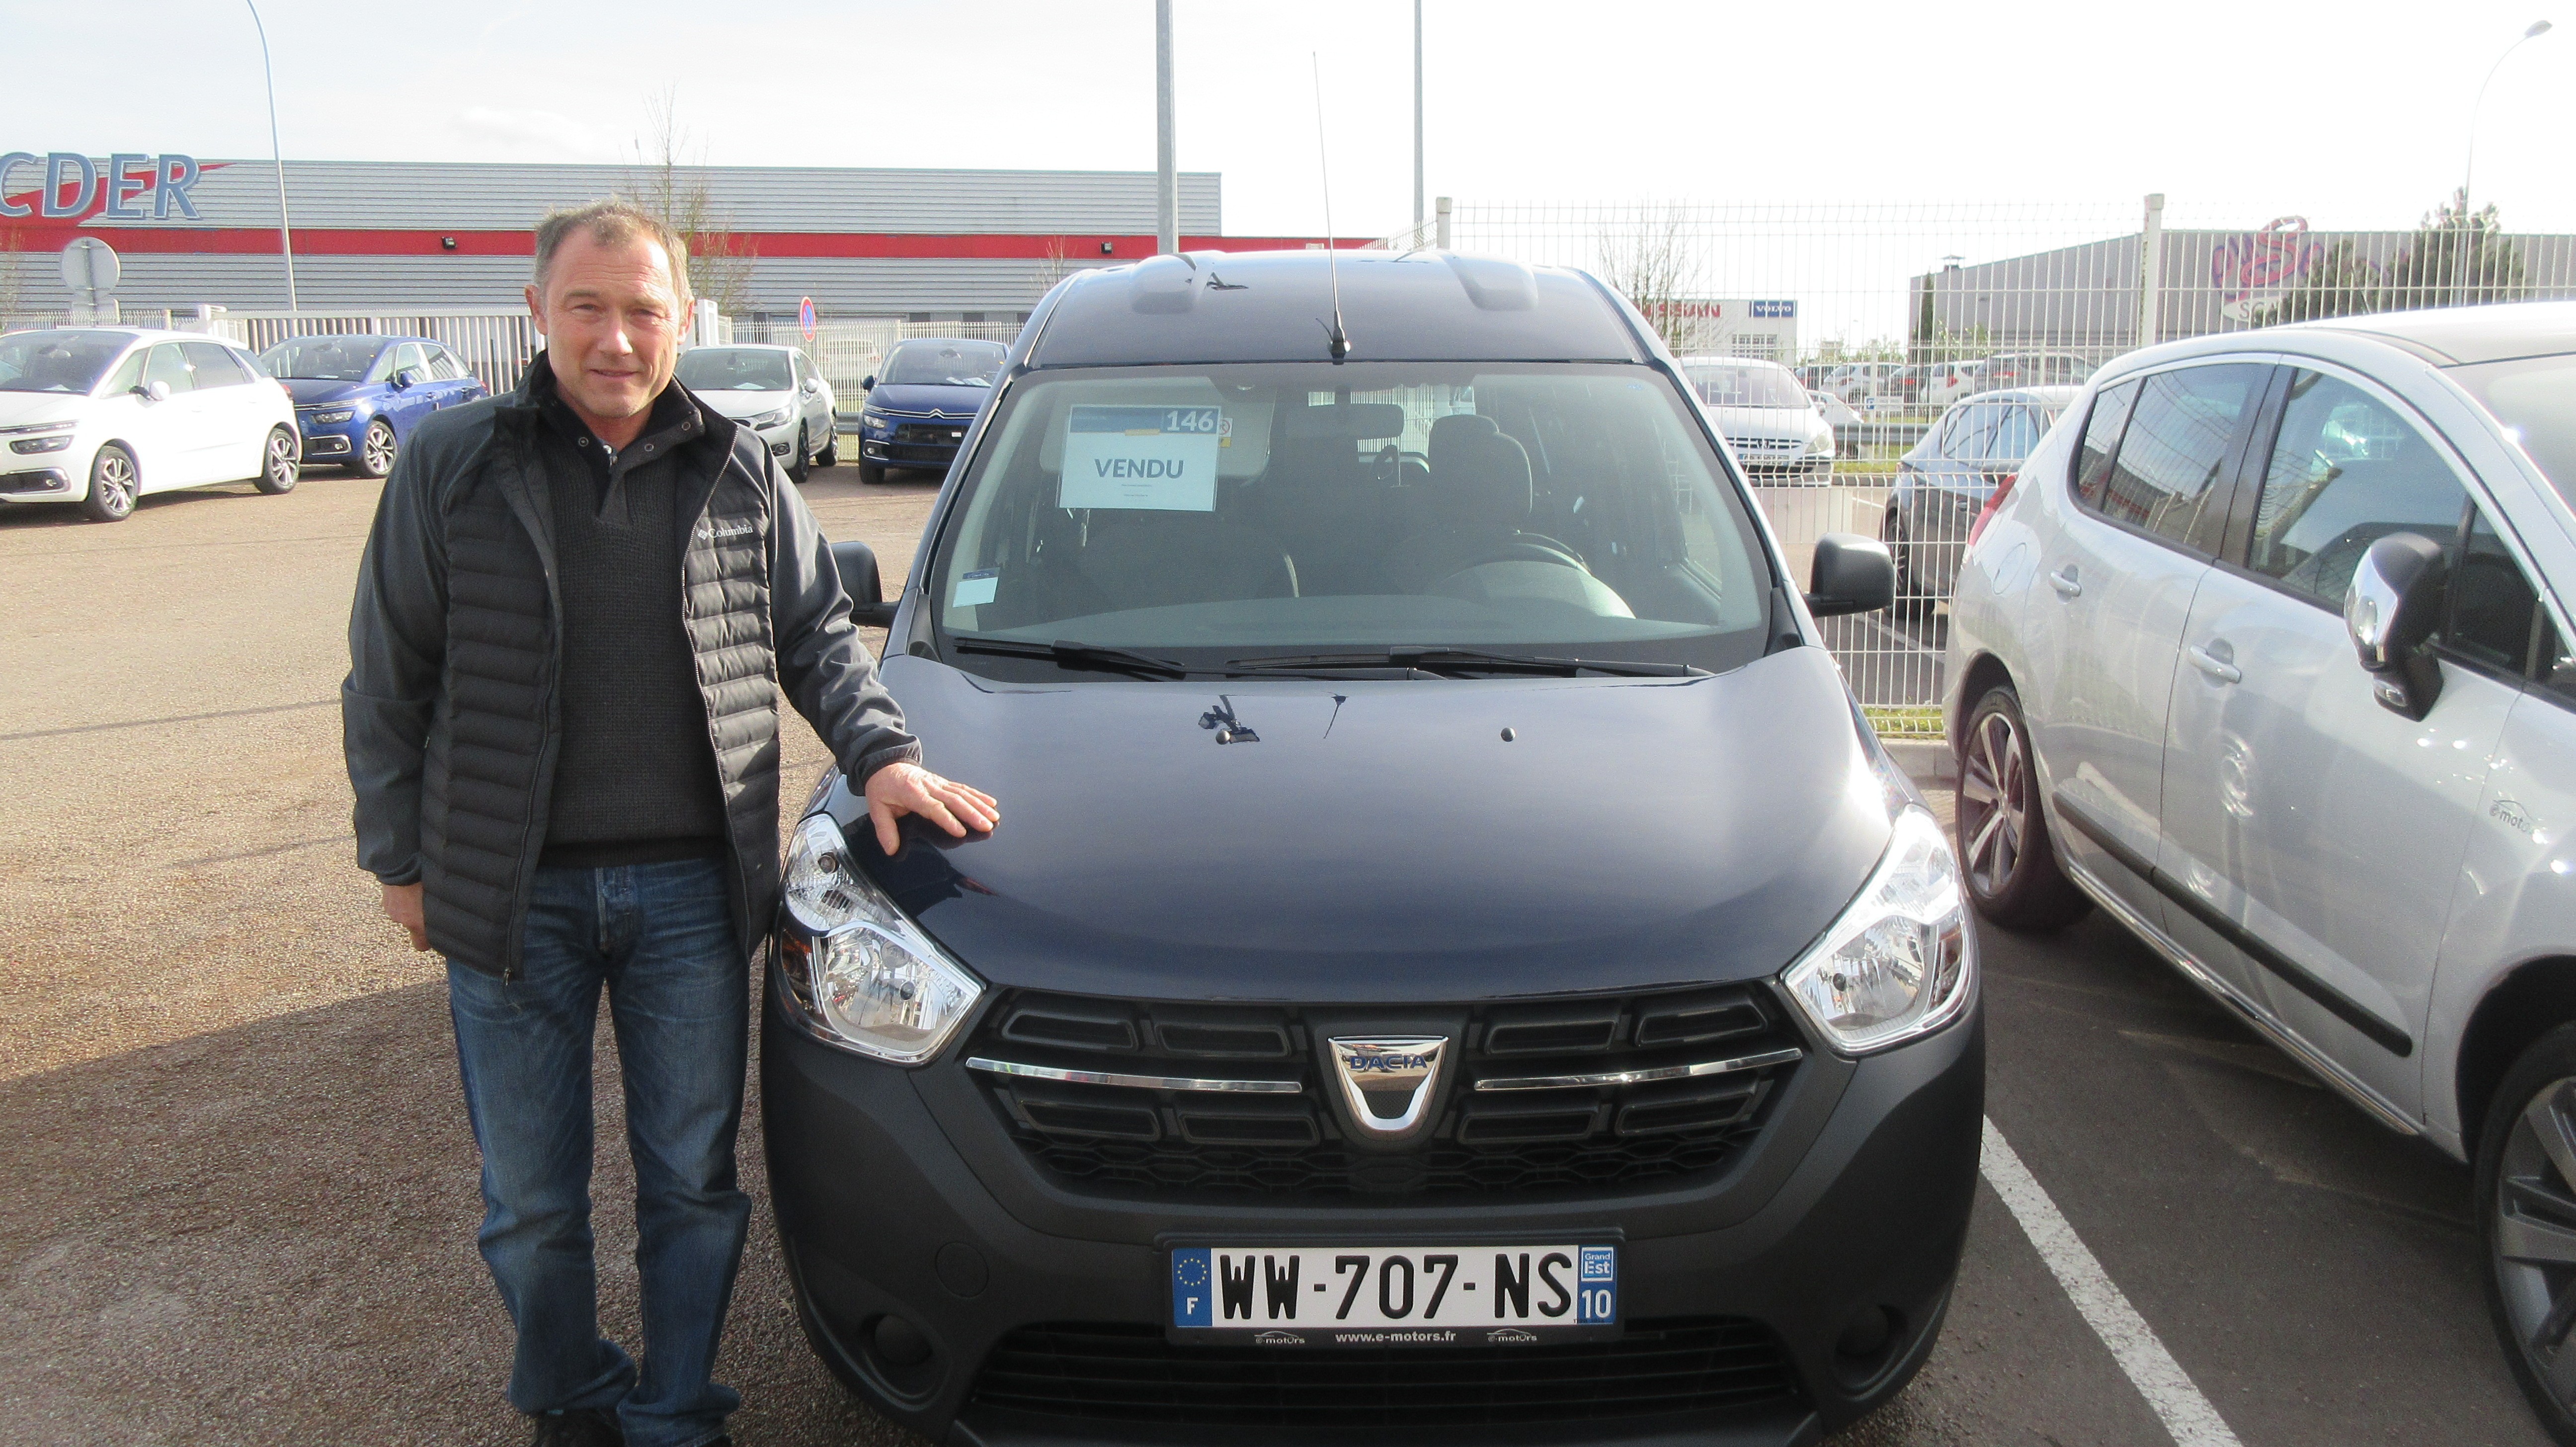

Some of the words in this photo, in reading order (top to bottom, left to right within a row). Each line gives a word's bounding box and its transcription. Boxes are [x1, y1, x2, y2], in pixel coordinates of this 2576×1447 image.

[1167, 410, 1214, 431] 146
[1094, 459, 1184, 479] VENDU
[708, 524, 753, 539] Columbia
[1350, 1055, 1428, 1070] DACIA
[1584, 1261, 1610, 1275] Est
[1187, 1297, 1199, 1315] F
[1582, 1289, 1611, 1318] 10
[1335, 1331, 1456, 1342] www.e-motors.fr
